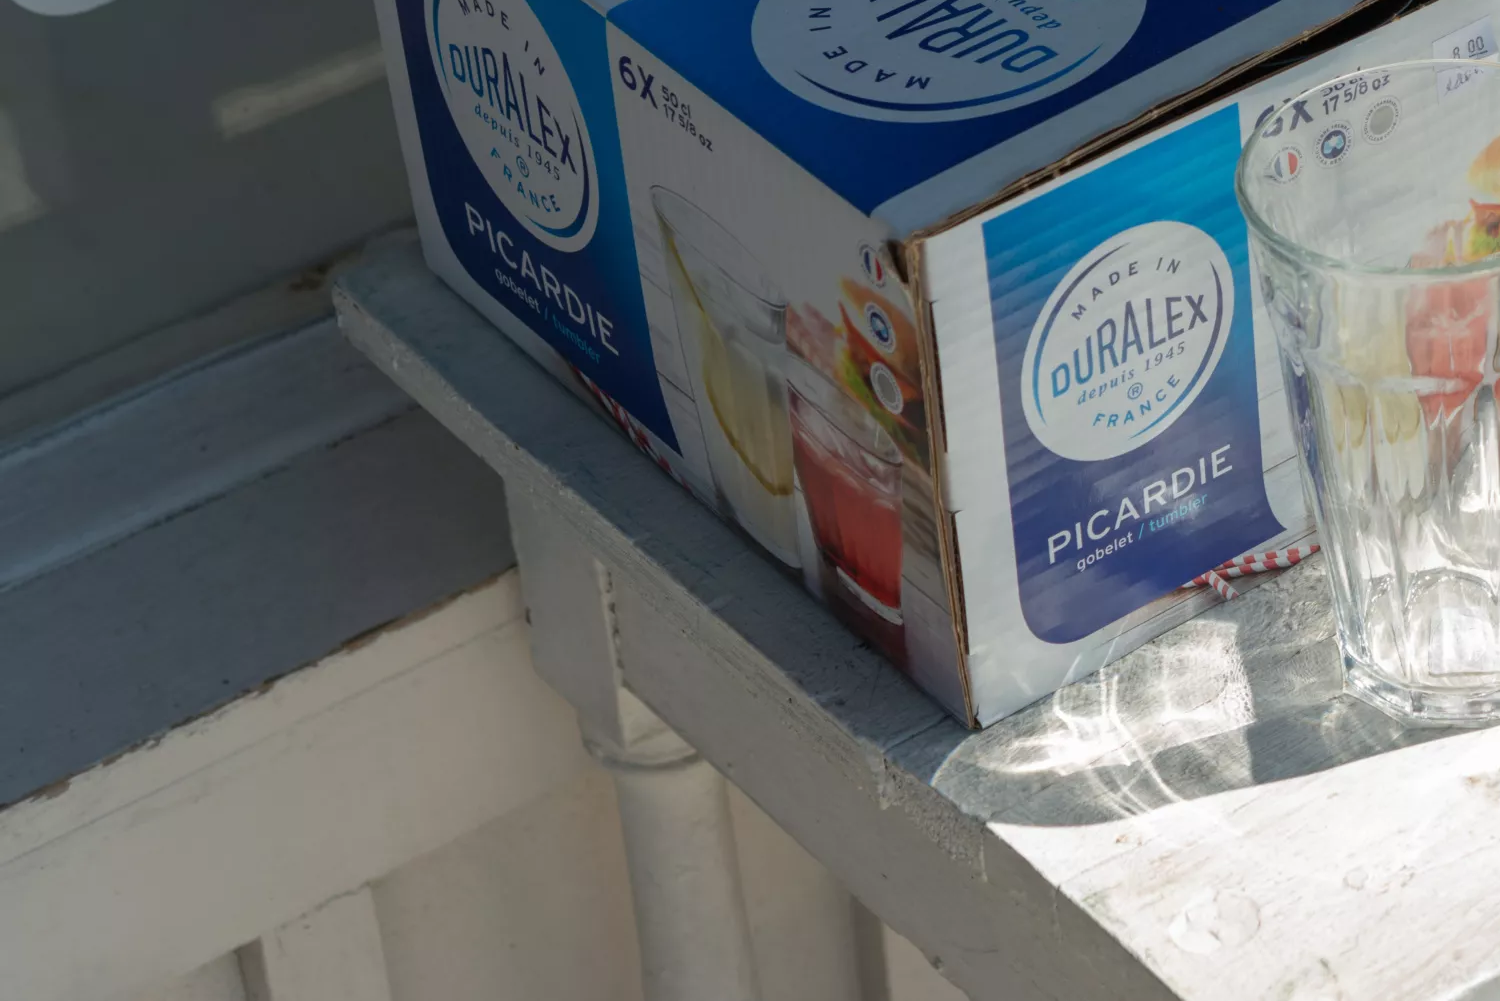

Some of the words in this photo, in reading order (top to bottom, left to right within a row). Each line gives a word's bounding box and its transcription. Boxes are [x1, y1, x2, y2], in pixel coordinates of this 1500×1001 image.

[807, 5, 834, 33] IN
[524, 40, 546, 76] IN
[619, 56, 658, 110] 6X
[821, 44, 932, 90] MADE
[449, 43, 578, 175] DURALEX
[663, 104, 675, 122] 17
[678, 114, 697, 136] 5/8
[1322, 96, 1338, 115] 17
[1343, 81, 1369, 103] 5/8
[474, 103, 520, 148] depuis
[527, 144, 561, 180] 1945
[490, 147, 561, 212] FRANCE
[464, 201, 620, 357] PICARDIE
[1071, 260, 1139, 321] MADE
[1156, 257, 1181, 274] IN
[495, 268, 541, 315] gobelet
[552, 313, 601, 365] tumbler
[1050, 294, 1208, 398] DURALEX
[1077, 367, 1135, 405] depuis
[1144, 341, 1185, 371] 1945
[1093, 374, 1180, 428] FRANCE
[1047, 444, 1234, 565] PICARDIE
[1076, 530, 1135, 572] gobelet
[1148, 494, 1209, 532] tumbler
